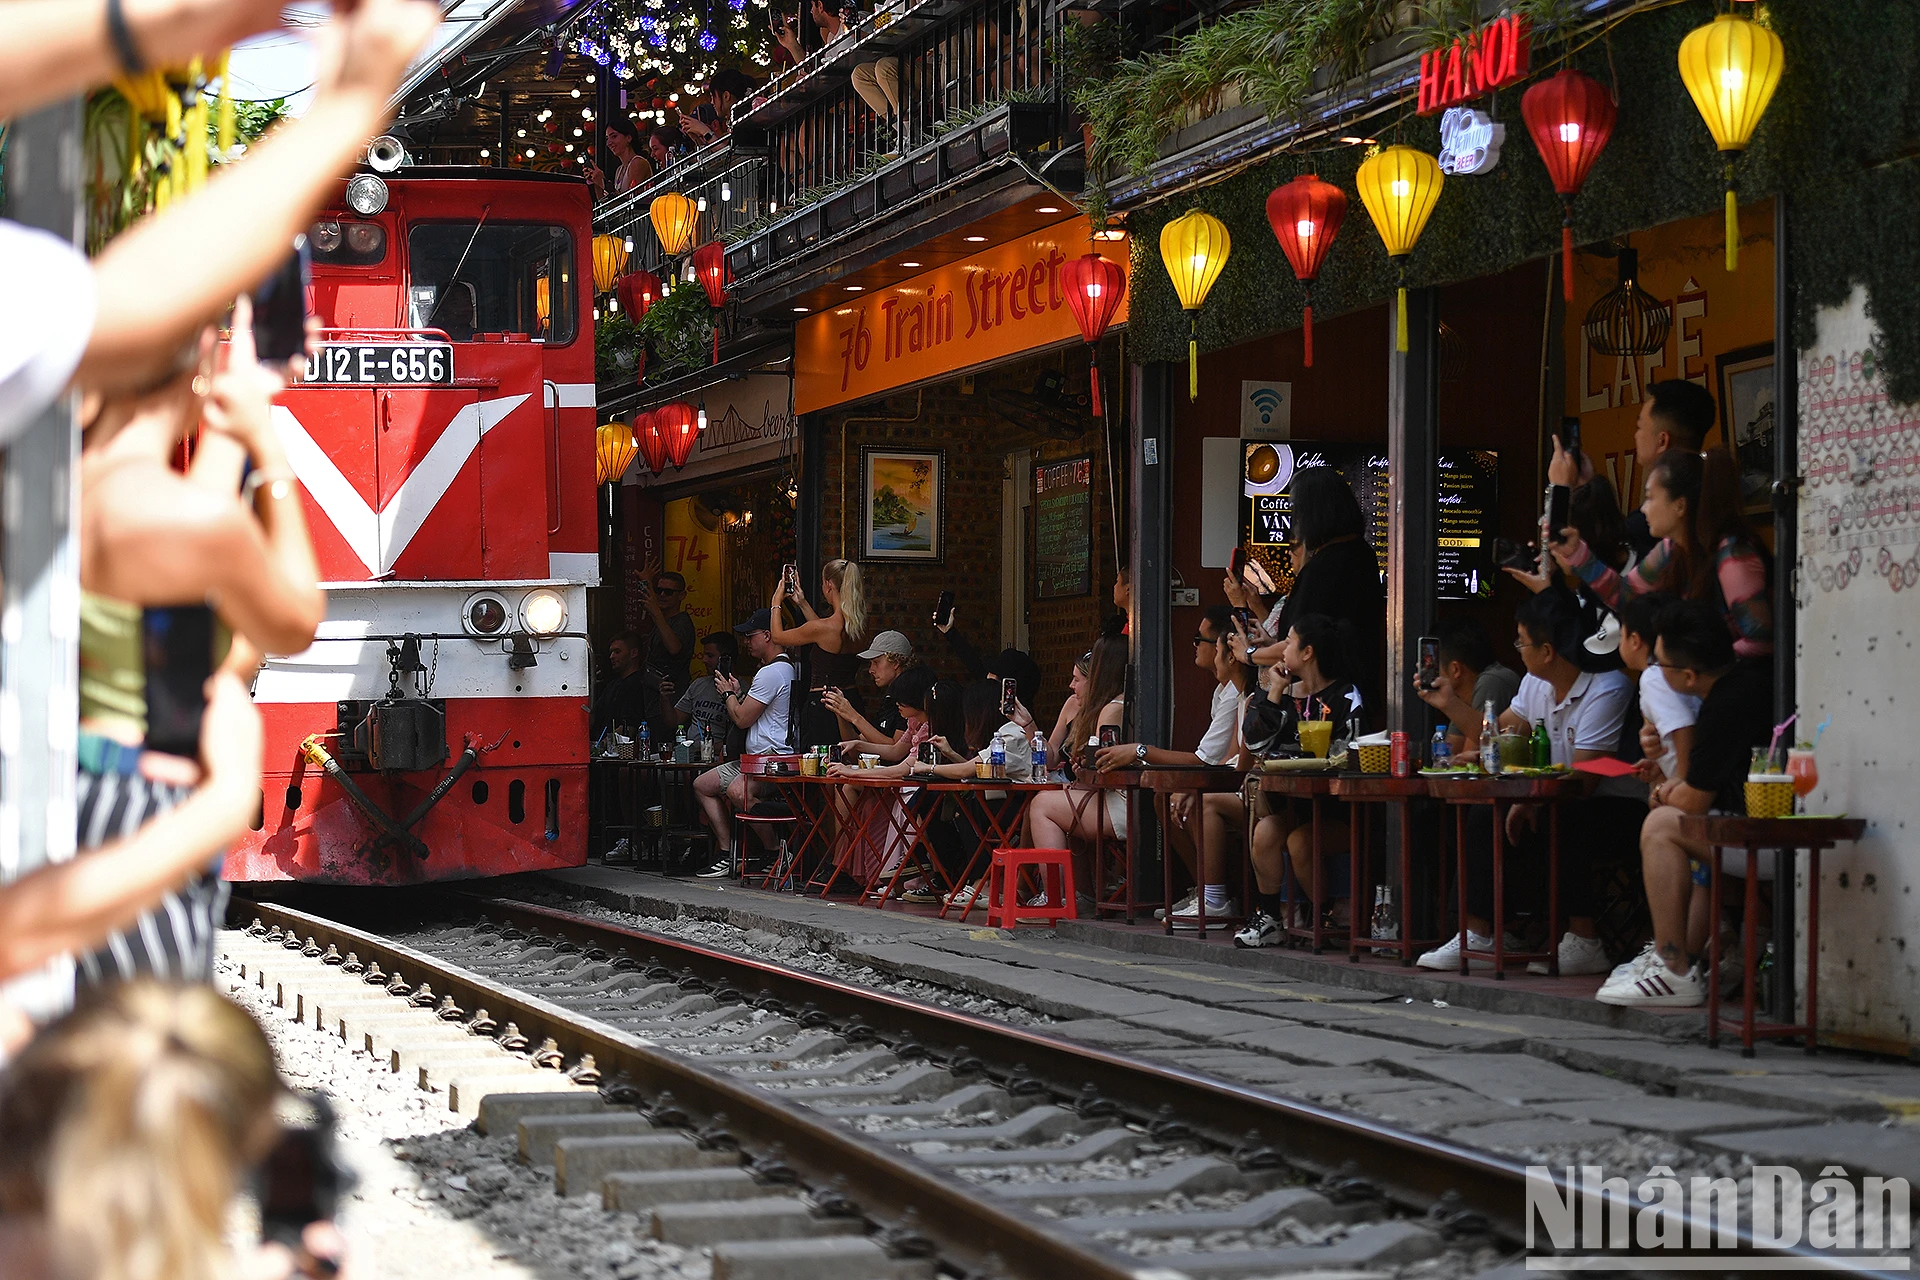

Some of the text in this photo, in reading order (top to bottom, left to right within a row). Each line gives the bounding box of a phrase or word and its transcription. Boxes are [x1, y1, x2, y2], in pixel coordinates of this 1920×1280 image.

[1416, 14, 1524, 118] HANOI
[1456, 154, 1475, 171] BEER
[839, 247, 1066, 393] 76 Train Street
[1044, 464, 1068, 491] COFFEE
[1261, 511, 1292, 530] VÂN
[1268, 531, 1284, 543] 78
[1442, 527, 1462, 535] Coconut
[666, 535, 710, 572] 74
[684, 603, 714, 618] Beer
[695, 699, 727, 714] NORTH
[695, 708, 724, 723] SAILS
